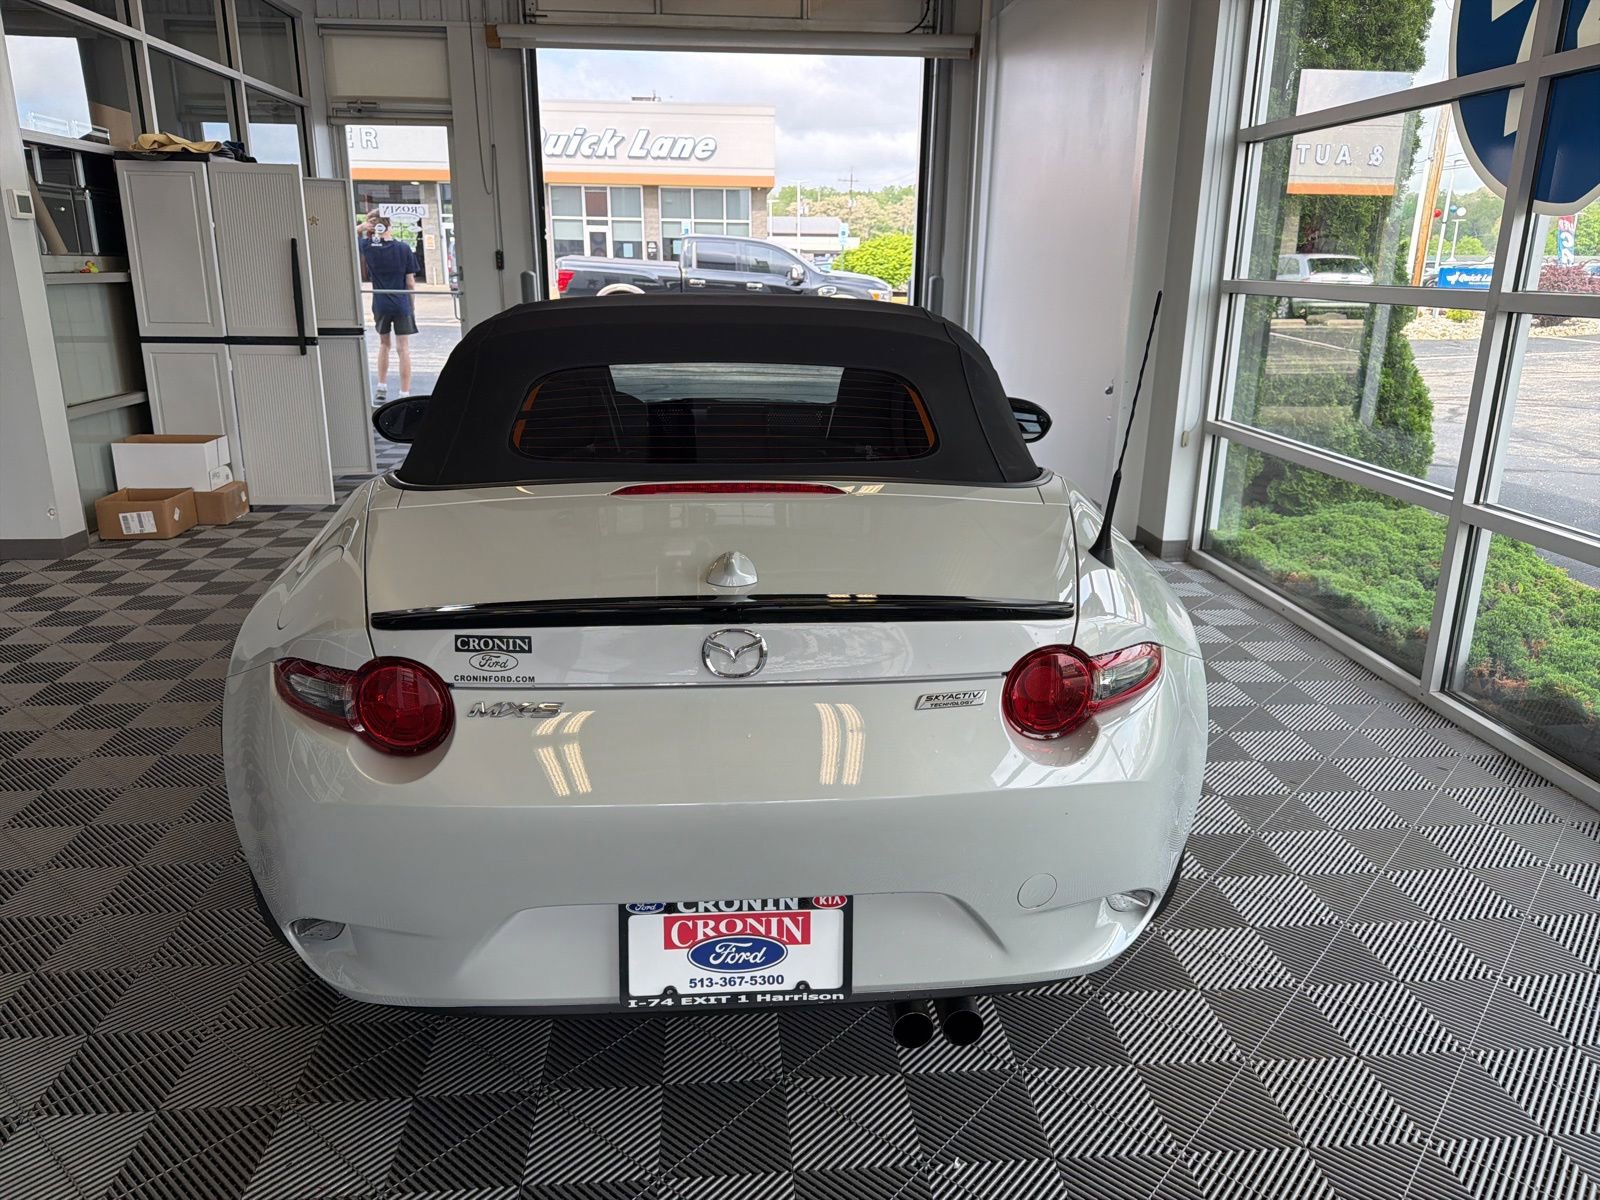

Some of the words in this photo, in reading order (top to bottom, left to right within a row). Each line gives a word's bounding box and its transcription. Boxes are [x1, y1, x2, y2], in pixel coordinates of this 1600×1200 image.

[541, 127, 625, 158] uick
[628, 128, 717, 161] Lane
[456, 637, 529, 651] CRONIN
[478, 654, 509, 669] Ford
[925, 692, 980, 701] SKYACTIV
[819, 896, 842, 905] KIA
[671, 917, 804, 947] CRONIN
[709, 942, 767, 965] Ford
[688, 974, 785, 989] 513-367-5300
[628, 998, 675, 1008] I-74
[681, 996, 731, 1005] EXIT
[756, 992, 845, 1003] Harrison
